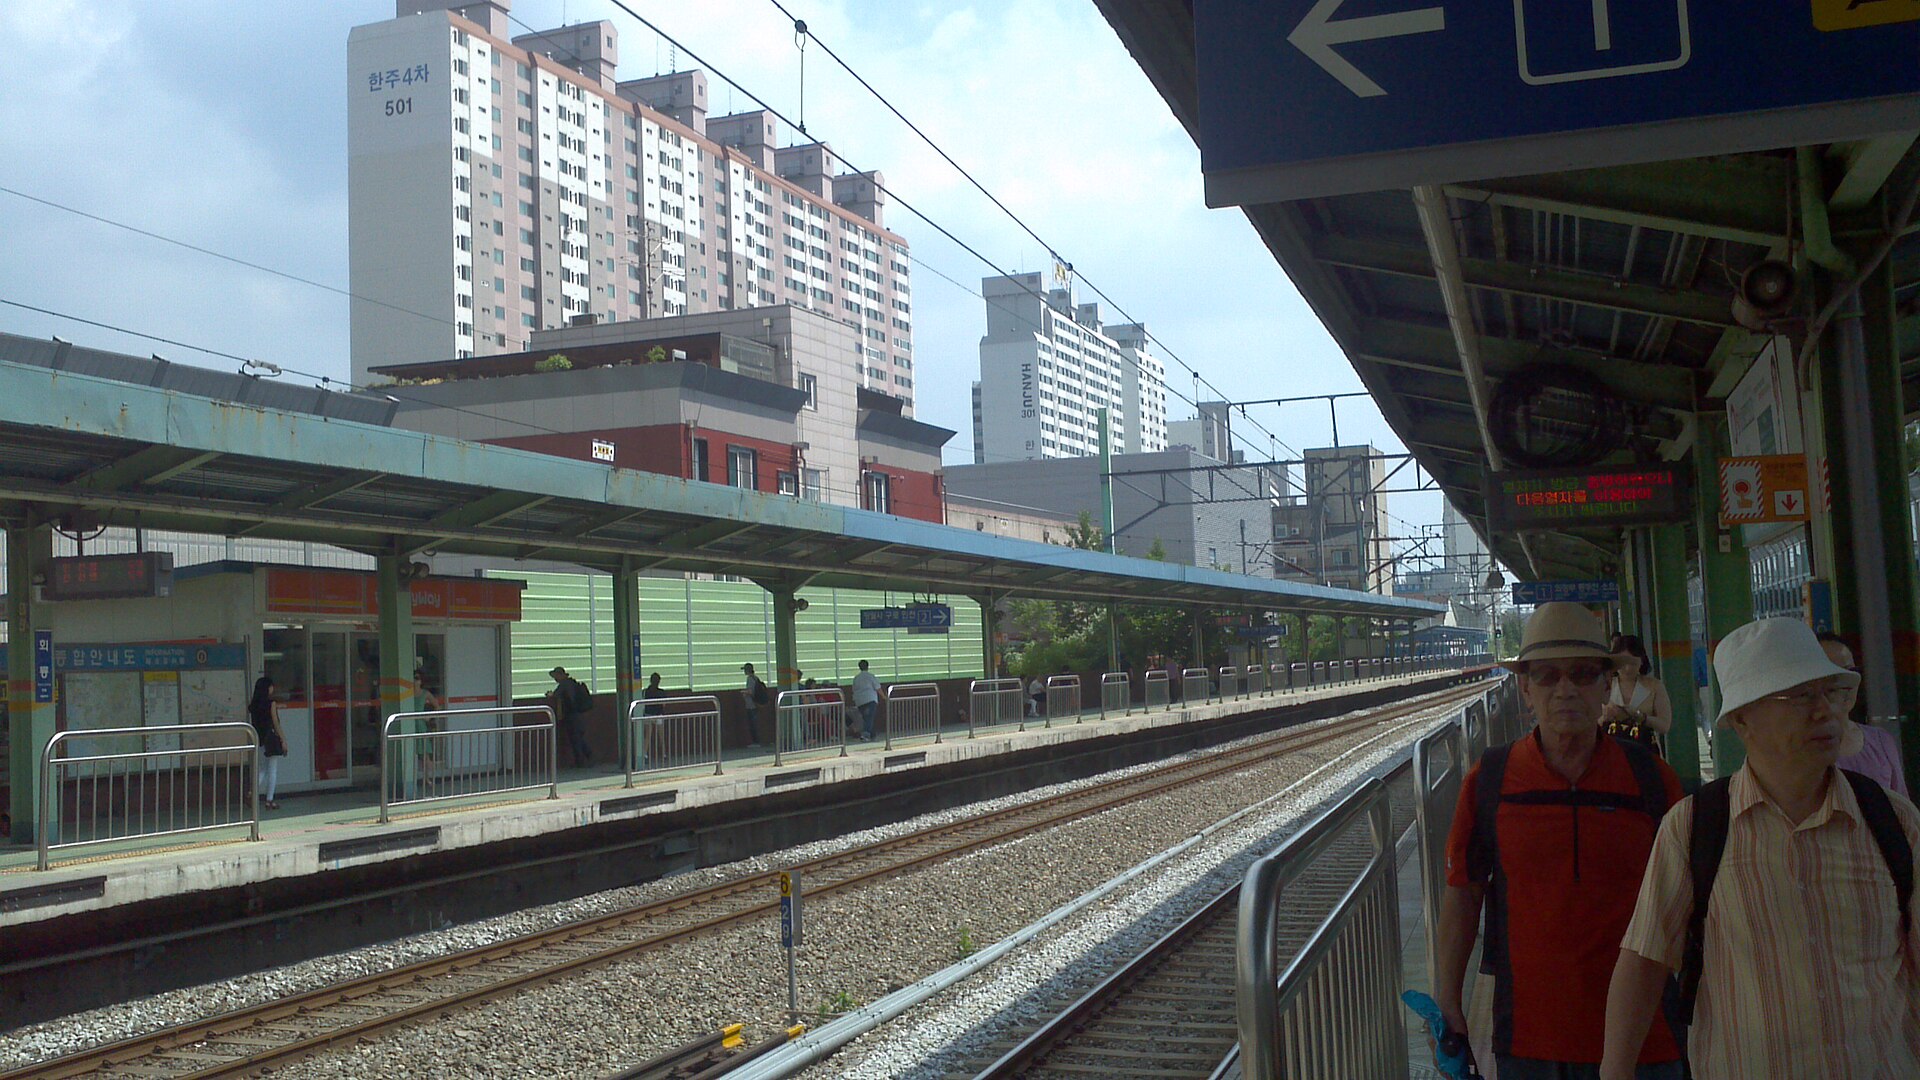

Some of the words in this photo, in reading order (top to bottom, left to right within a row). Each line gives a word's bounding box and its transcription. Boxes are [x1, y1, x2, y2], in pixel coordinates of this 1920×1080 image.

[368, 64, 430, 92] 한주4차
[385, 97, 412, 117] 501
[1021, 363, 1032, 408] HANJU
[1021, 409, 1036, 418] 301
[1516, 490, 1587, 506] 다음열차를
[55, 648, 136, 667] 종합안내도
[781, 874, 788, 893] 6
